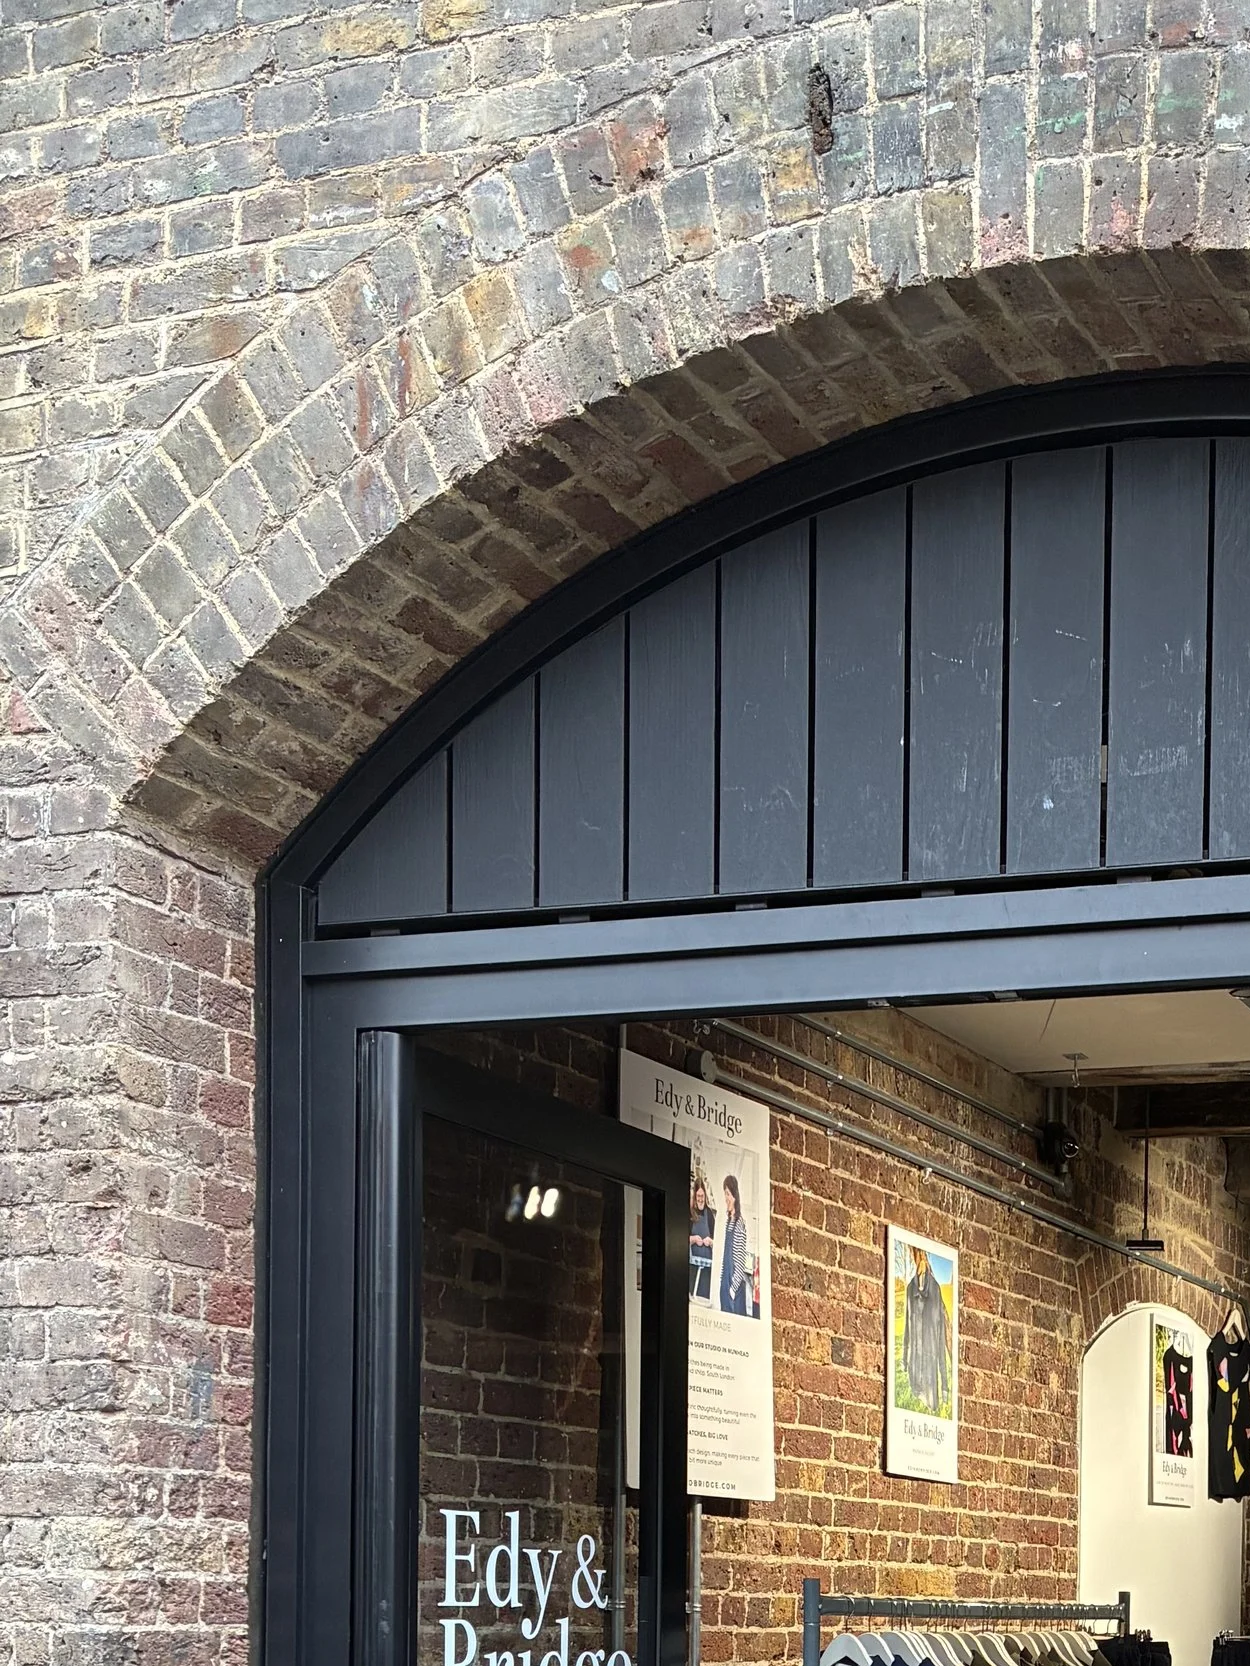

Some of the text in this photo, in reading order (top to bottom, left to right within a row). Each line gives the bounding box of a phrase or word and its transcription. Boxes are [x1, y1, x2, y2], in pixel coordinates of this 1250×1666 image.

[654, 1078, 742, 1138] Edy & Bridge
[923, 1422, 945, 1445] Bridge
[688, 1479, 737, 1490] DBRIDGE.COM
[437, 1508, 609, 1640] Edy &
